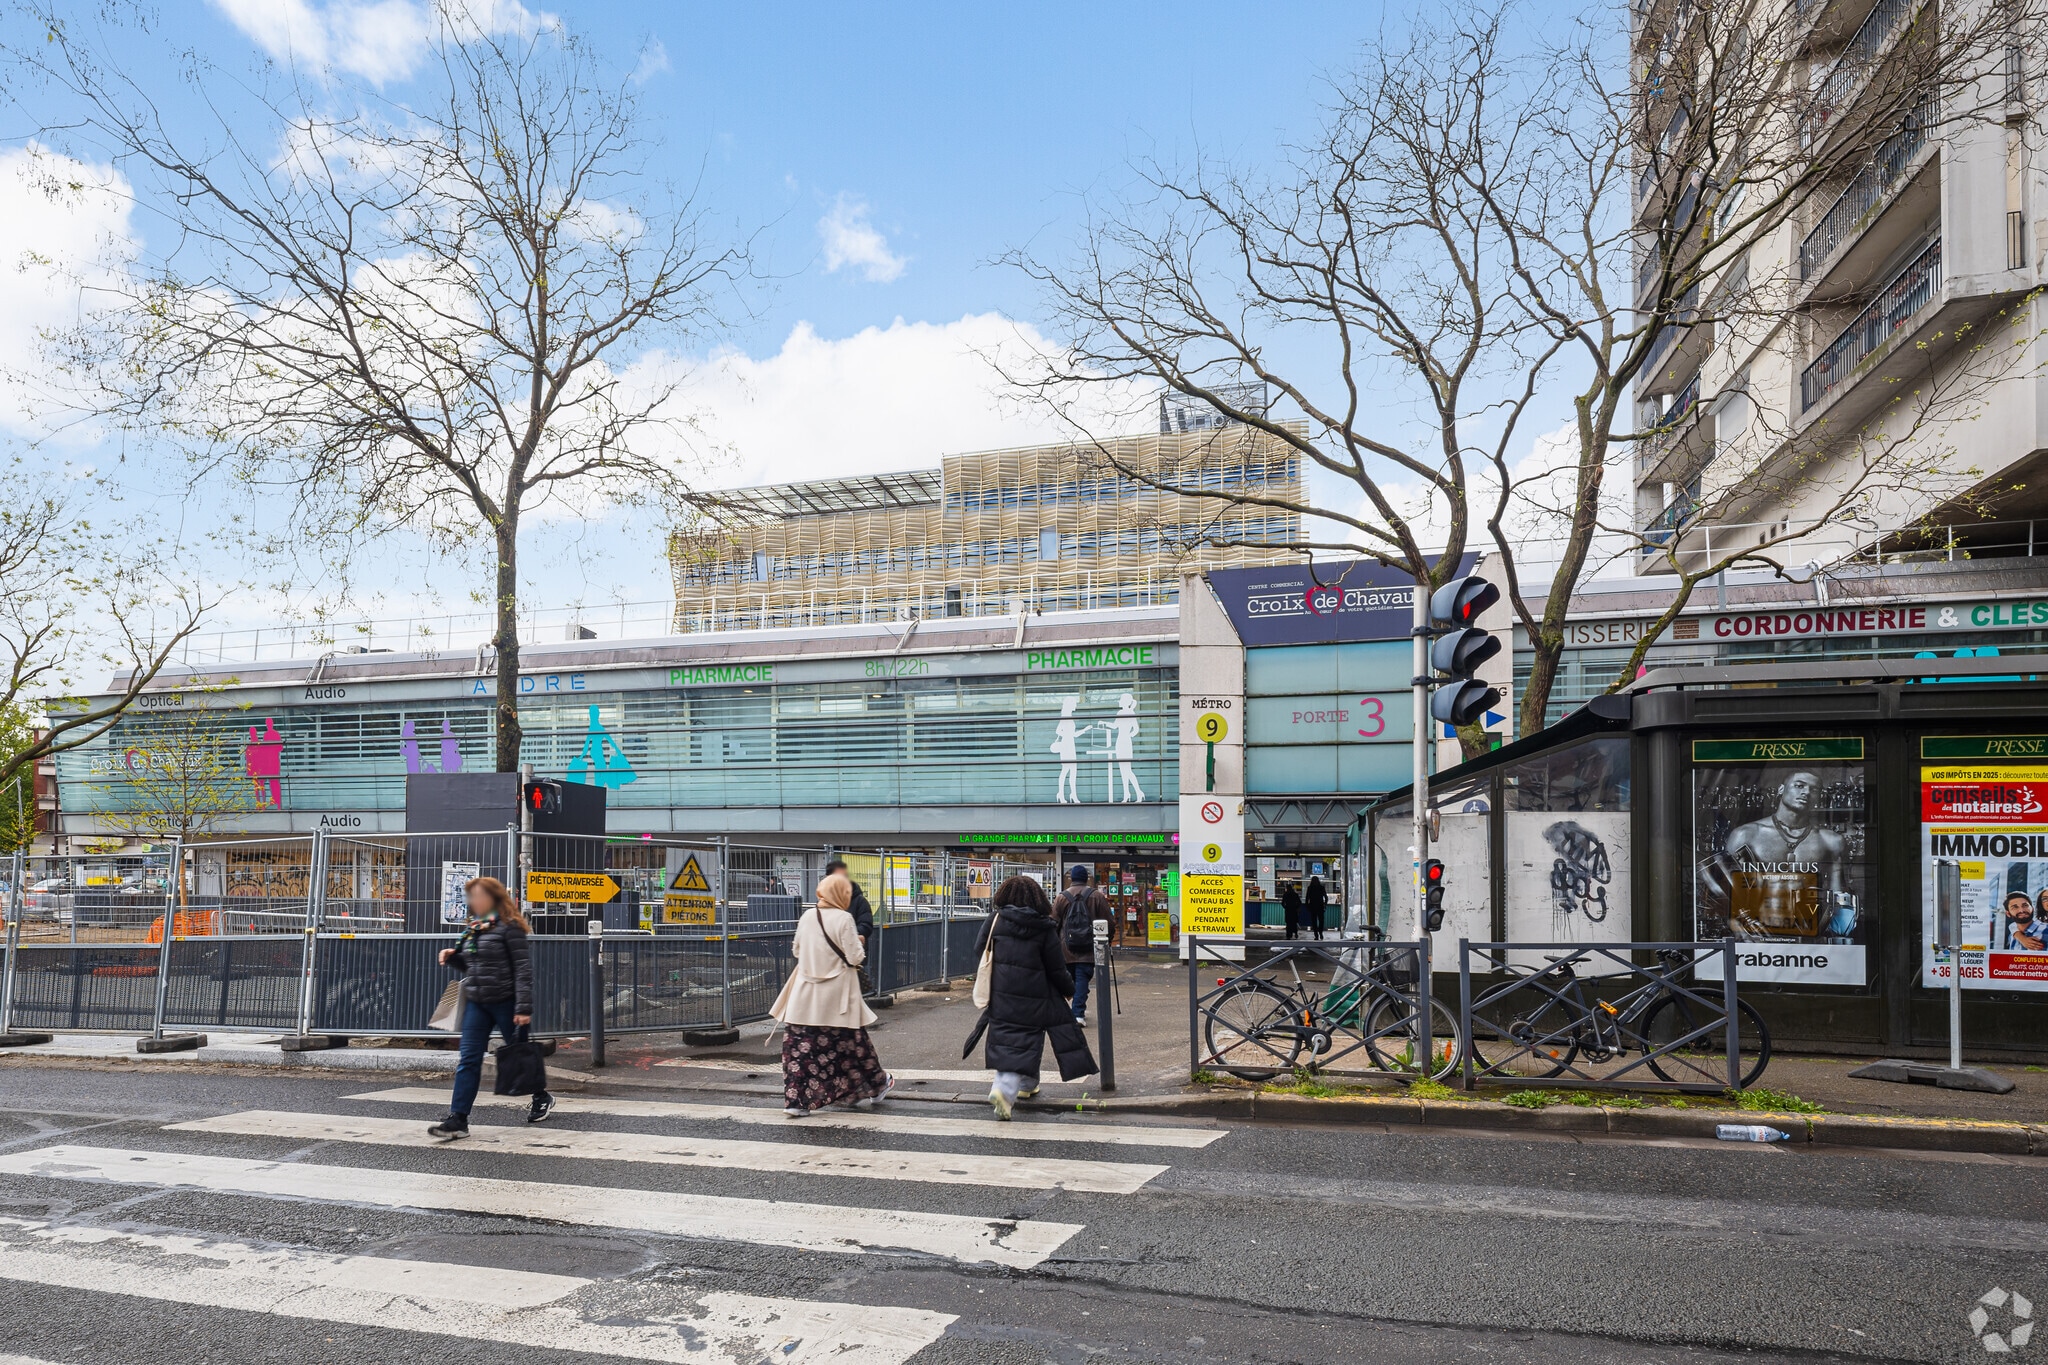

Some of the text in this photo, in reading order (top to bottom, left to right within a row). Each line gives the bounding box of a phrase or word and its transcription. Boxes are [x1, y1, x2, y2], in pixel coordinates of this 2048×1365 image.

[1247, 591, 1414, 613] Croix de Chavau
[1714, 607, 1926, 638] CORDONNERIE
[1938, 607, 1959, 628] &
[1971, 601, 2048, 627] CLÉS
[1027, 646, 1153, 670] PHARMACIE
[670, 665, 773, 685] PHARMACIE
[472, 673, 586, 694] ADRÉ
[305, 687, 346, 700] Audio
[139, 694, 185, 709] Optical
[1192, 697, 1231, 709] MÉTRO
[1292, 697, 1385, 737] PORTE 3
[1206, 719, 1218, 737] 9
[1751, 743, 1806, 759] PRESSE
[1985, 740, 2045, 756] PRESSE
[1946, 770, 1971, 779] IMPÔTS
[1931, 786, 2017, 803] conseils
[1952, 801, 2023, 813] notaires
[320, 815, 361, 827] Audio
[959, 835, 970, 843] LA
[972, 834, 1005, 843] GRANDE
[1008, 834, 1054, 843] PHARMACIE
[1057, 834, 1068, 843] DE
[1070, 834, 1081, 843] LA
[1084, 834, 1108, 843] CROIX
[1112, 834, 1123, 843] DE
[1126, 834, 1165, 843] CHAVAUX
[1208, 847, 1216, 859] 9
[1742, 862, 1819, 873] INVICTUS
[544, 890, 591, 900] OBLIGATOIRE
[666, 899, 713, 908] ATTENTION
[671, 910, 708, 921] PIÉTONS
[1736, 952, 1828, 968] rabanne
[1939, 966, 1951, 977] 36
[1959, 967, 1984, 979] AGES
